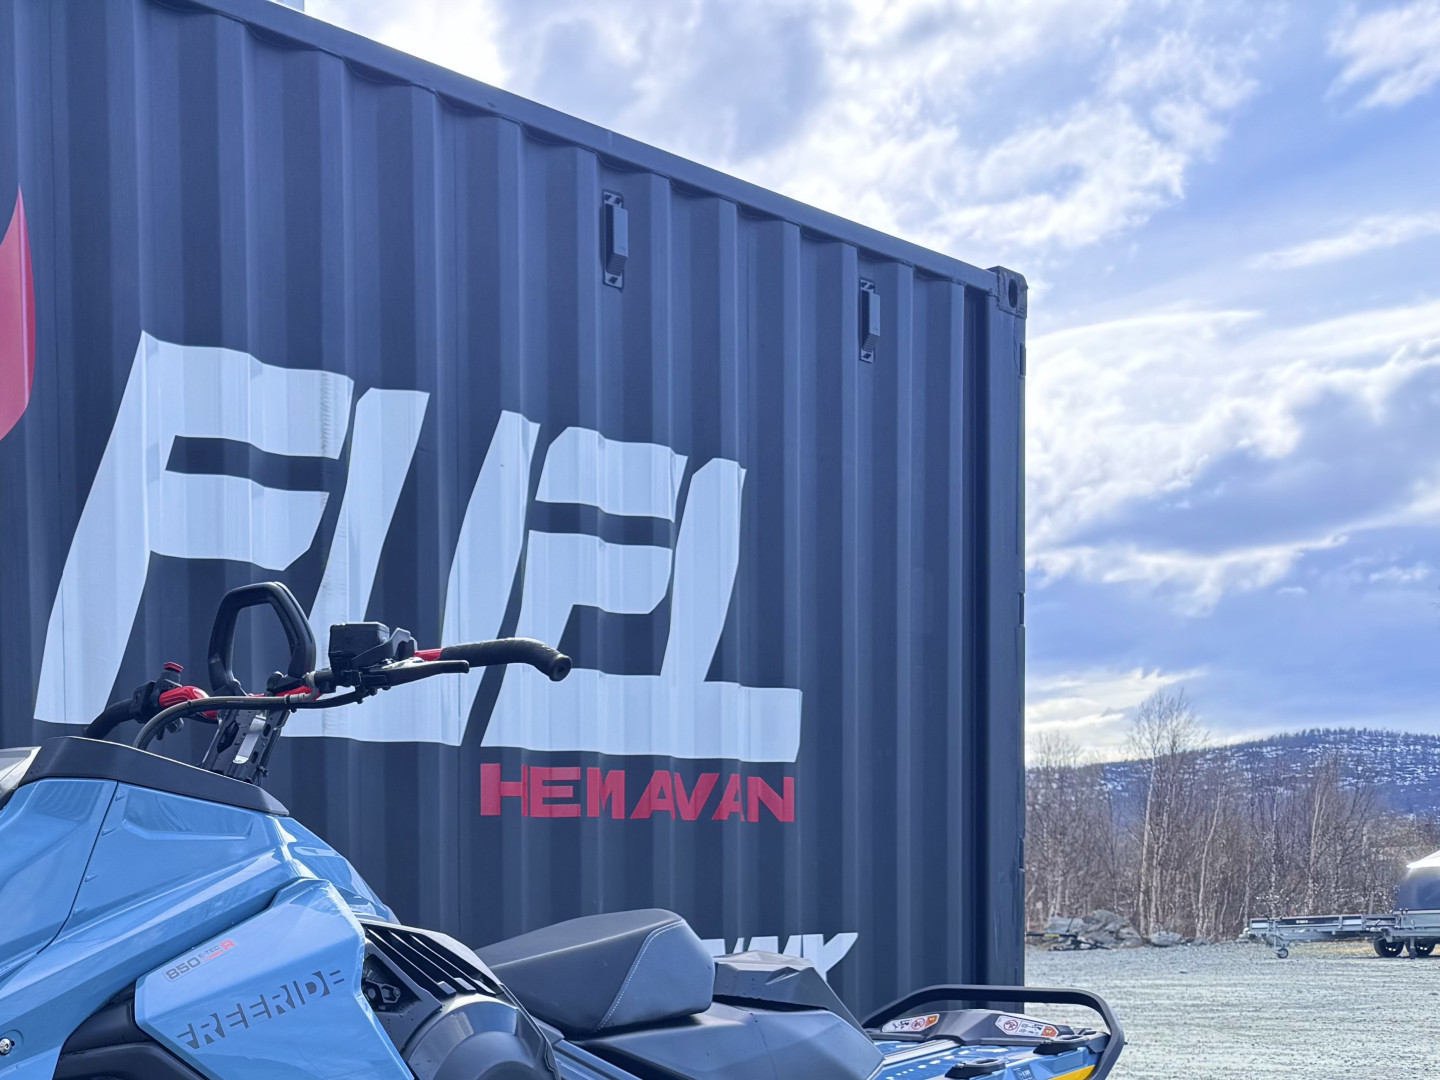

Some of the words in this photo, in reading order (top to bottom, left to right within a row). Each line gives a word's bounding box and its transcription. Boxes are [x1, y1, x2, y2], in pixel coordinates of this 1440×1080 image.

[34, 331, 802, 762] FUEL
[479, 762, 796, 823] HEMAVAN
[165, 957, 202, 980] 850
[176, 970, 345, 1050] FREERIDE
